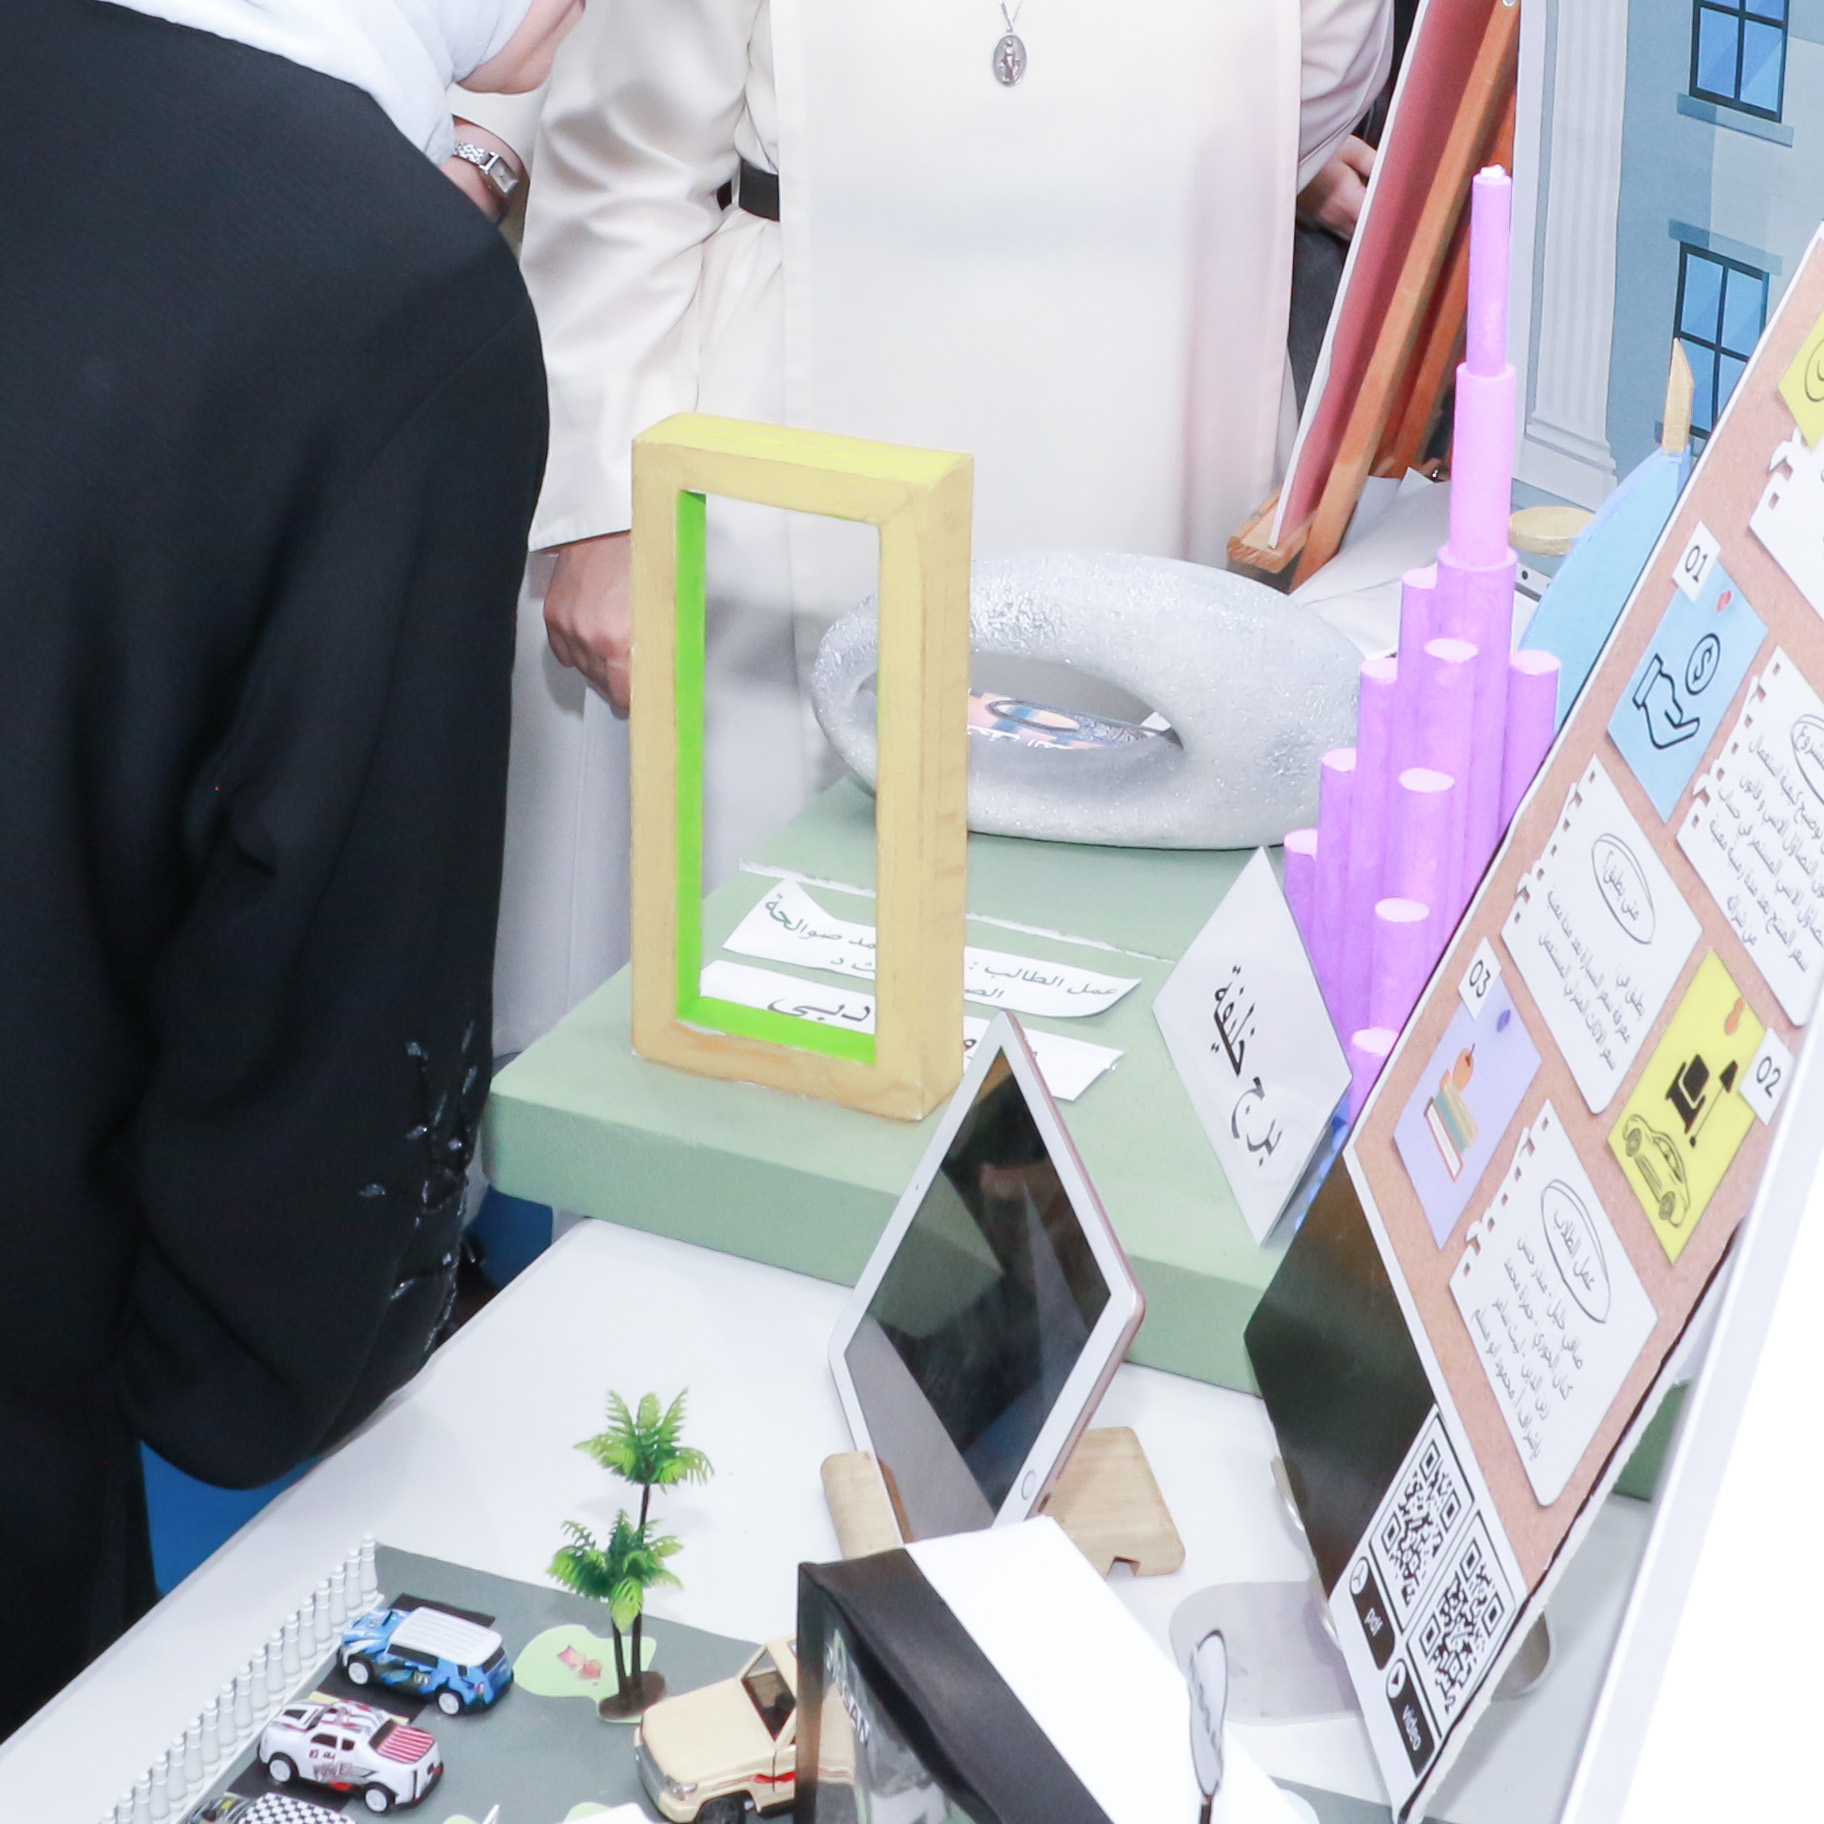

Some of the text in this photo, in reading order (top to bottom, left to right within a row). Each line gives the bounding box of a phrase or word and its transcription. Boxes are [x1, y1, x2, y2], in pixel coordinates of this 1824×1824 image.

[1683, 543, 1709, 584] 01
[1619, 897, 1640, 922] متى
[963, 988, 1005, 999] الص
[984, 967, 1065, 987] الطالب
[1066, 982, 1119, 997] عمل
[1467, 958, 1492, 999] 03
[1211, 964, 1283, 1167] برج خليفة
[1754, 1054, 1782, 1099] 02
[1552, 1209, 1595, 1292] عمل الطلاب
[1402, 1704, 1421, 1752] video
